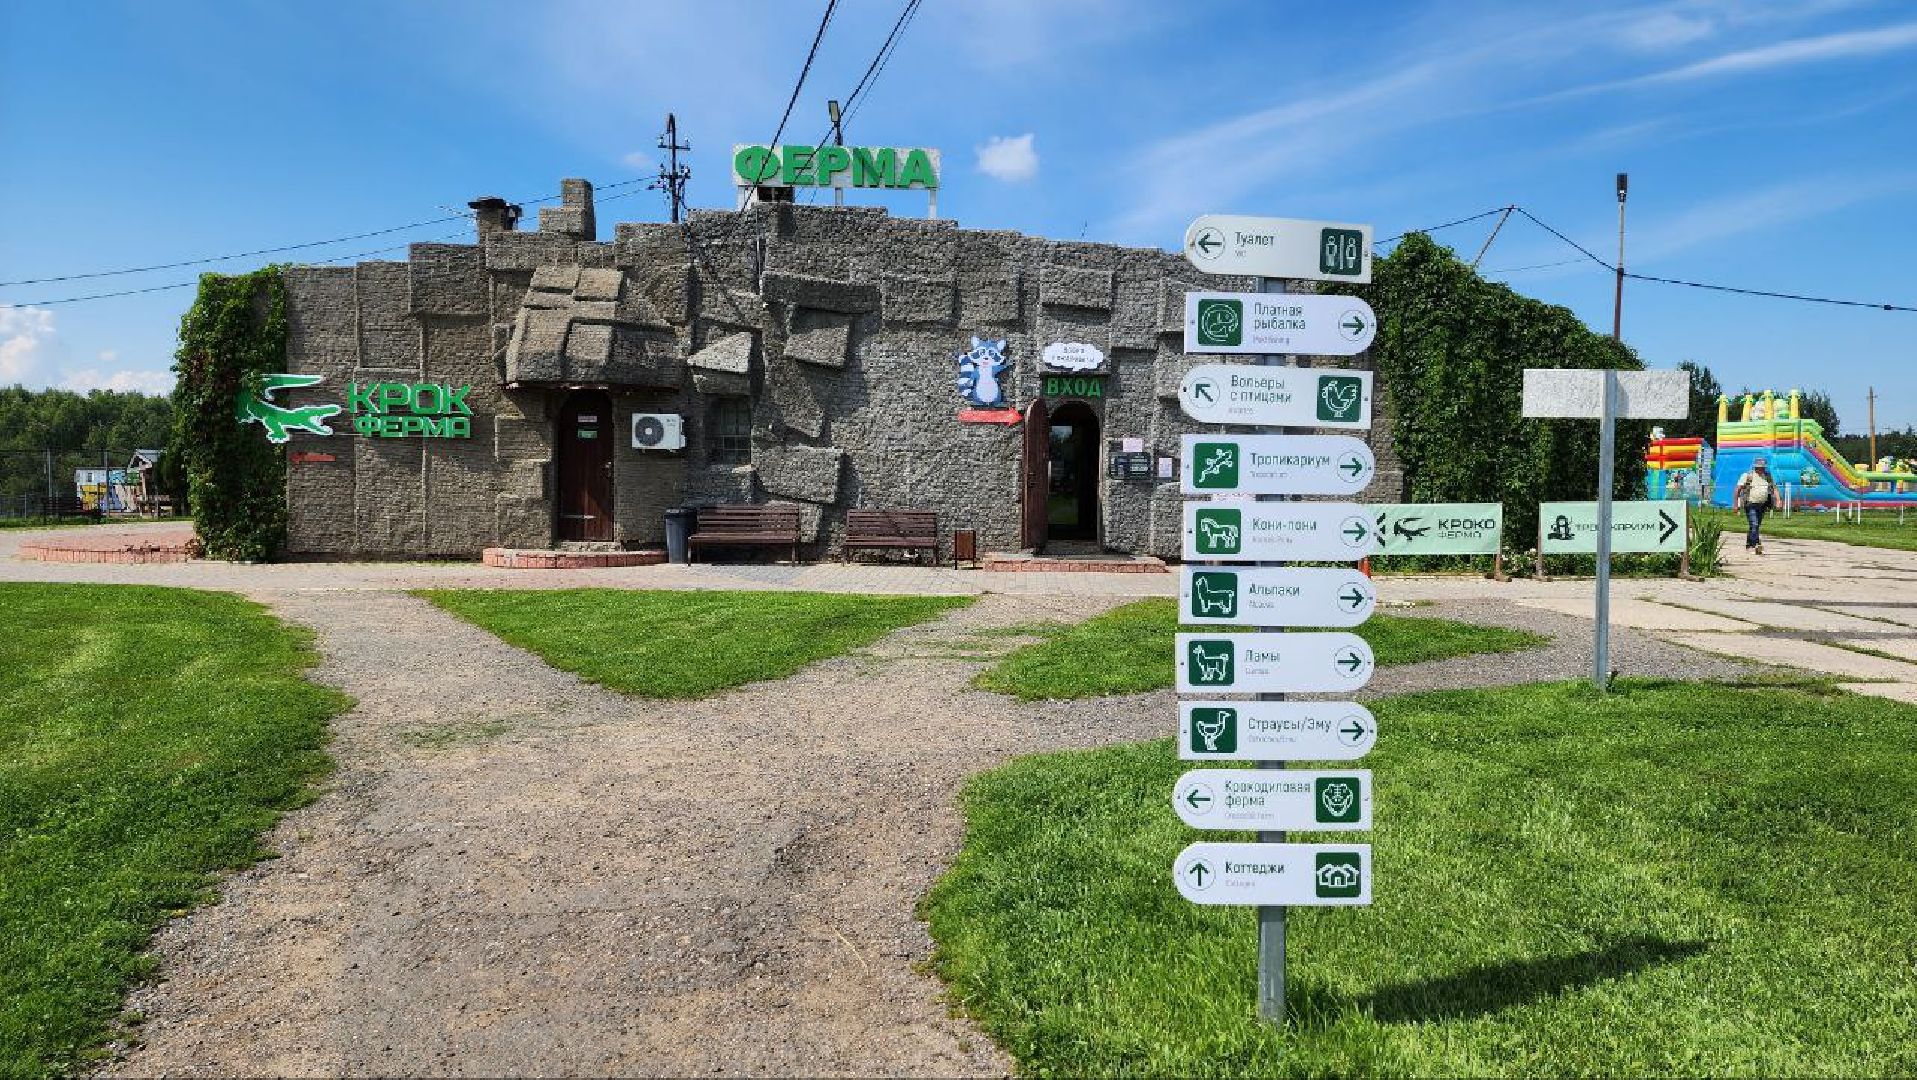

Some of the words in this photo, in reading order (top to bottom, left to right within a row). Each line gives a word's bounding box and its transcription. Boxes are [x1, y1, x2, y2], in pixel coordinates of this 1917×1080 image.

[735, 145, 938, 188] ФЕРМА
[1235, 231, 1275, 247] Туалет
[1254, 302, 1302, 316] Платная
[1253, 317, 1306, 330] рыбалка
[1046, 377, 1101, 397] ВХОД
[1231, 374, 1285, 390] Вольеры
[348, 383, 473, 415] КРОК
[1230, 391, 1238, 401] с
[1240, 391, 1292, 404] птицами
[354, 414, 471, 438] ФЕРМА
[1250, 452, 1330, 467] Тропикариум
[1252, 518, 1317, 531] Кони-пони
[1438, 518, 1496, 530] КРОКО
[1249, 583, 1300, 597] Альпаки
[1244, 649, 1281, 663] Ламы
[1248, 716, 1332, 731] Страусы/Эму
[1225, 780, 1311, 793] Крокодиловая
[1225, 794, 1265, 807] ферма
[1225, 861, 1285, 875] Коттеджи
